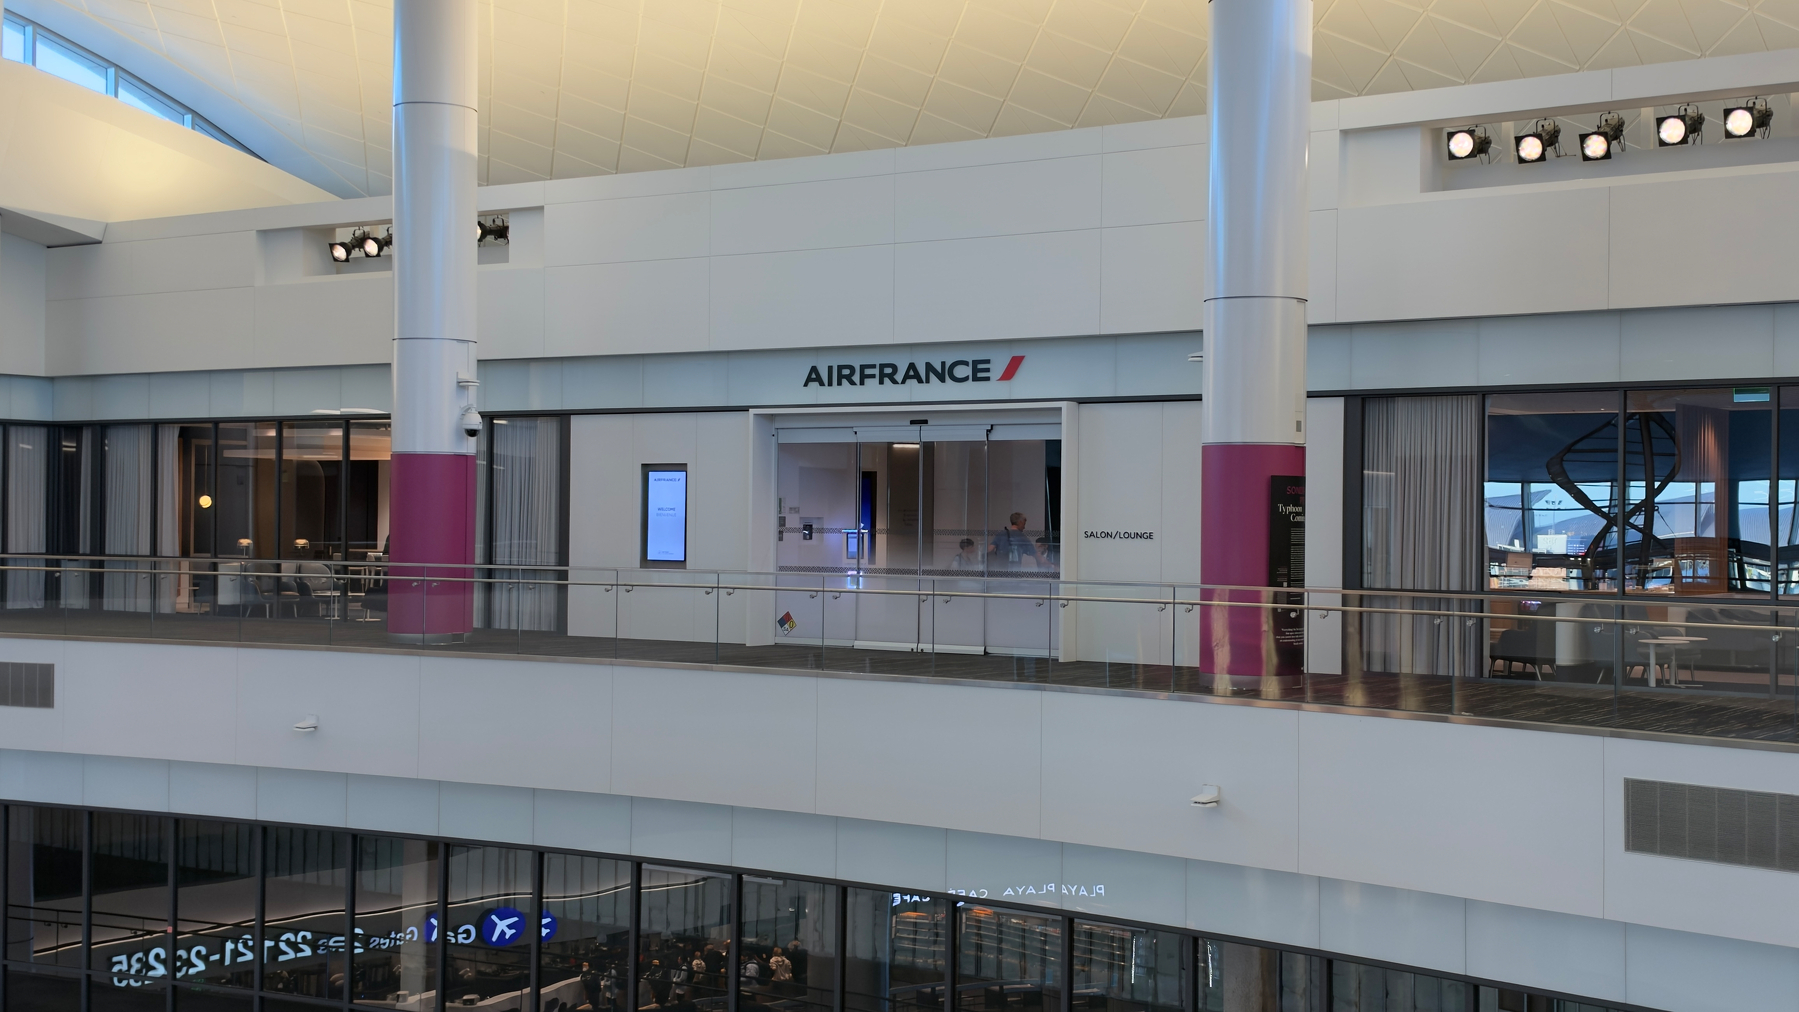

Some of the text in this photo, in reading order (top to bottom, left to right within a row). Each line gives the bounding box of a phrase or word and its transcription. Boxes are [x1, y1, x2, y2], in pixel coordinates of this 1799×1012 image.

[803, 359, 991, 387] AIRFRANCE
[1277, 504, 1303, 515] Typhoon
[1084, 530, 1154, 540] SALON/LOUNGE
